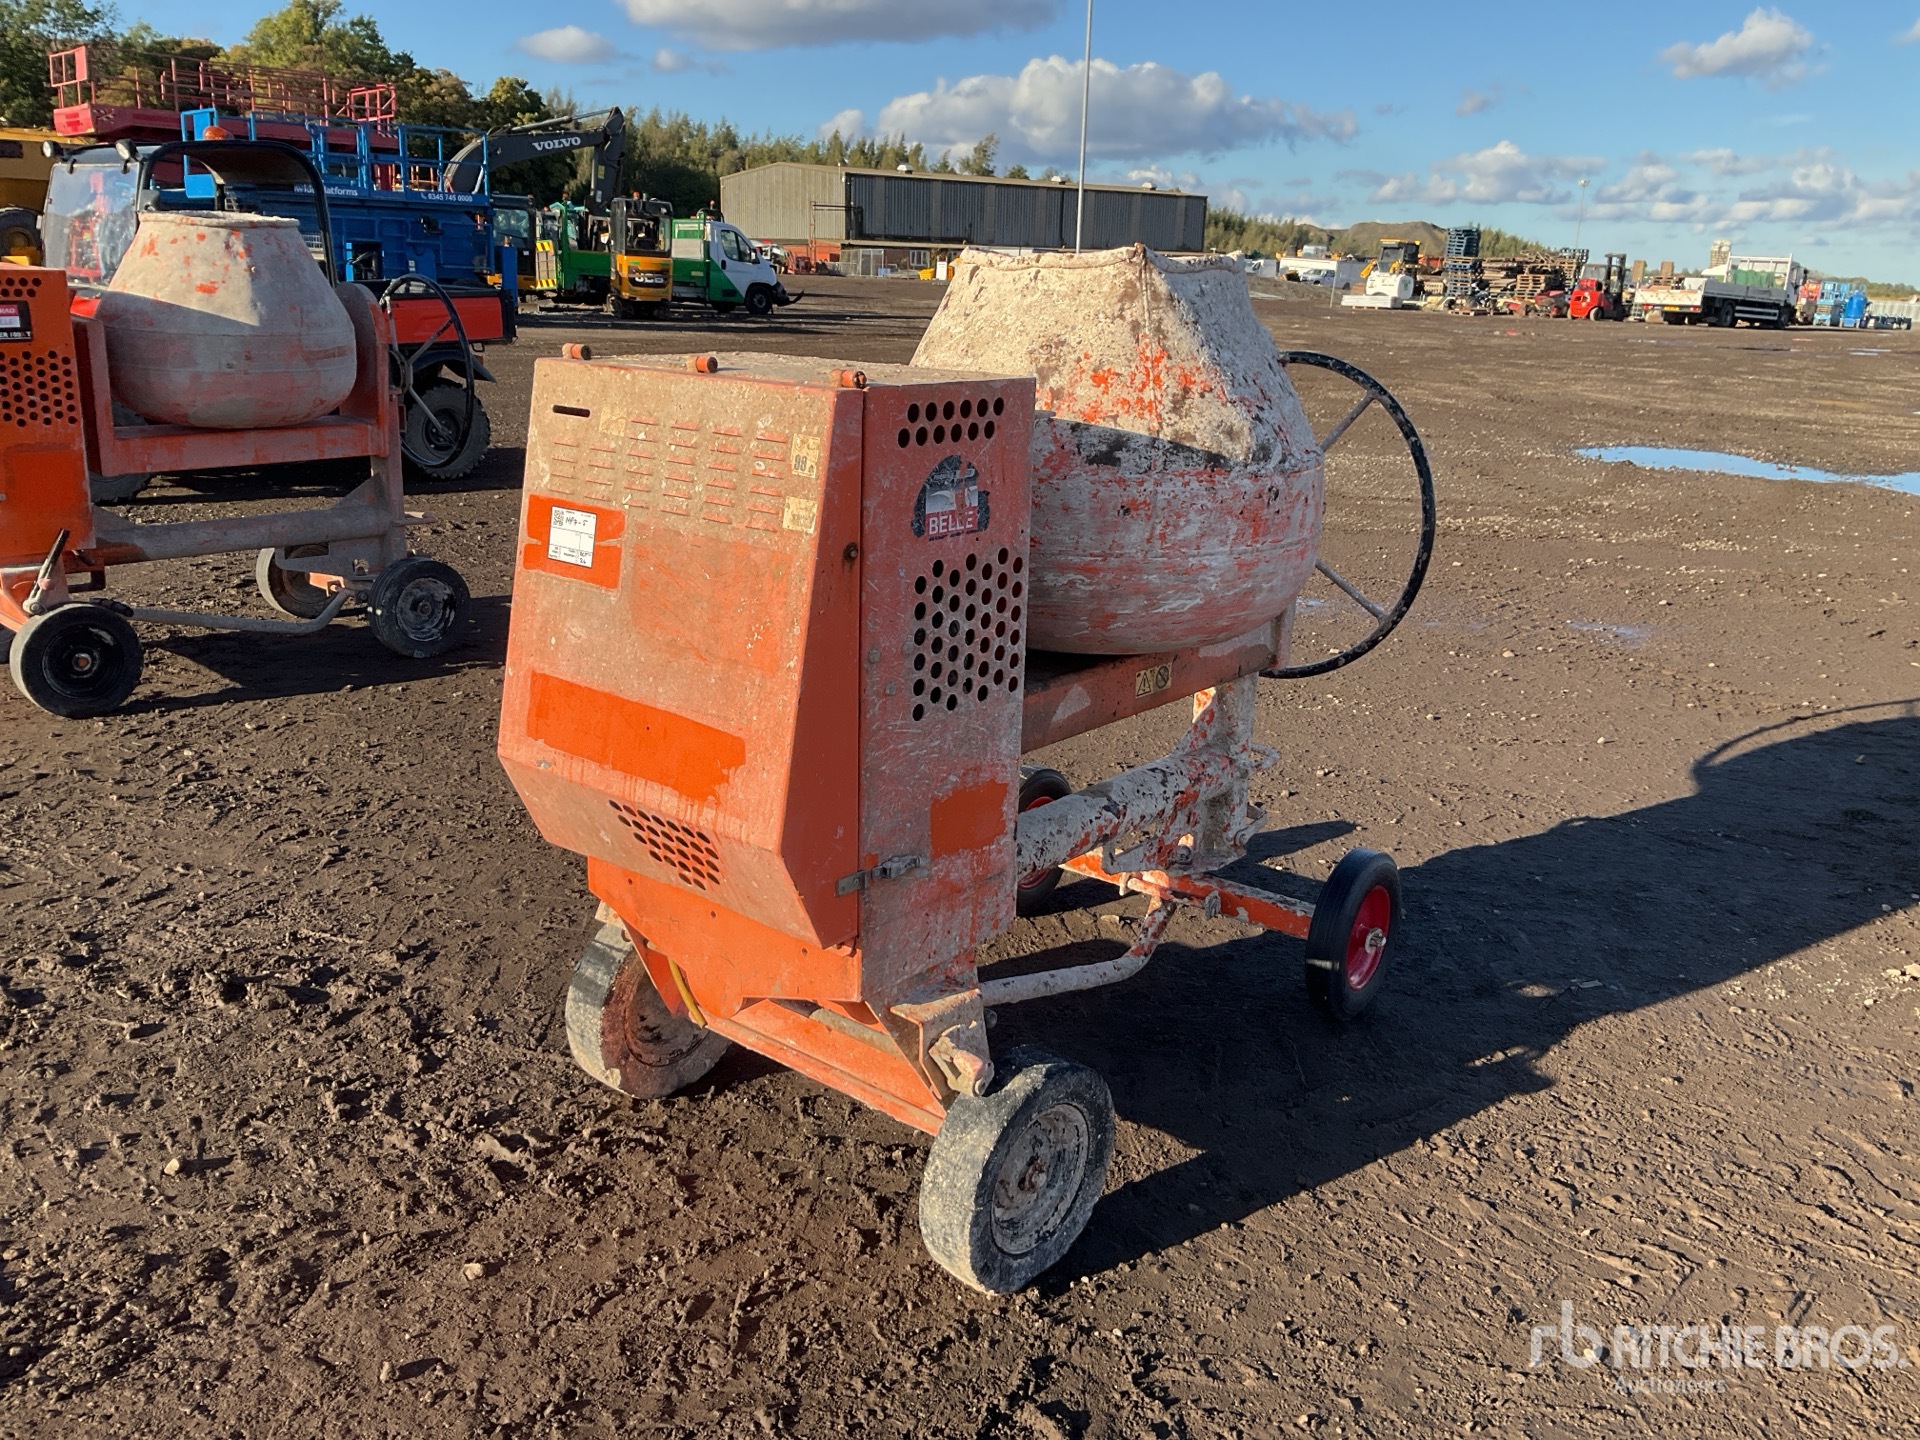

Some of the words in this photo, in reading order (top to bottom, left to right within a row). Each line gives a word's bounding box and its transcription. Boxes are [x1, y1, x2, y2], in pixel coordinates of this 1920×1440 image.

[532, 136, 581, 151] VOLVO
[324, 186, 358, 196] latforms
[929, 511, 975, 535] BELLE
